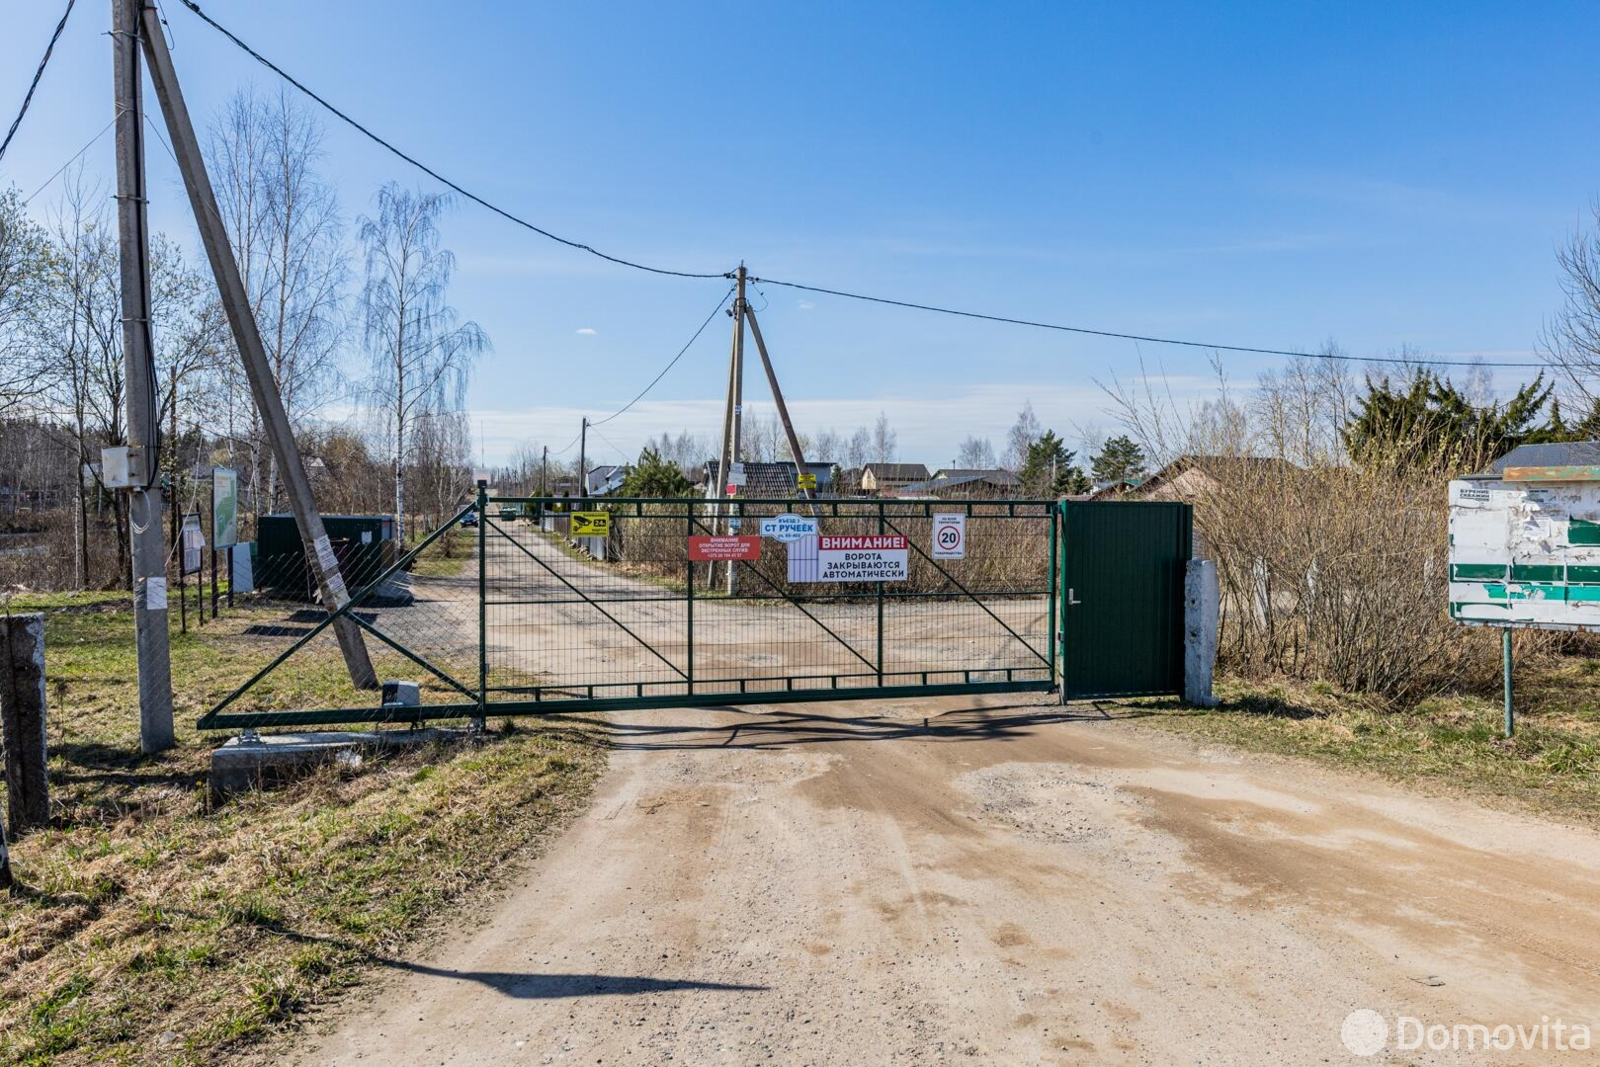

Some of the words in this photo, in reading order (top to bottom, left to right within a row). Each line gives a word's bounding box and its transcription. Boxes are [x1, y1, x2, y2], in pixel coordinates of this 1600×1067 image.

[822, 536, 905, 548] ВНИМАНИЕ!
[942, 532, 956, 543] 20
[827, 561, 900, 570] ЗАКРЫВАЮТСЯ
[822, 570, 904, 578] АВТОМАТИЧЕСКИ
